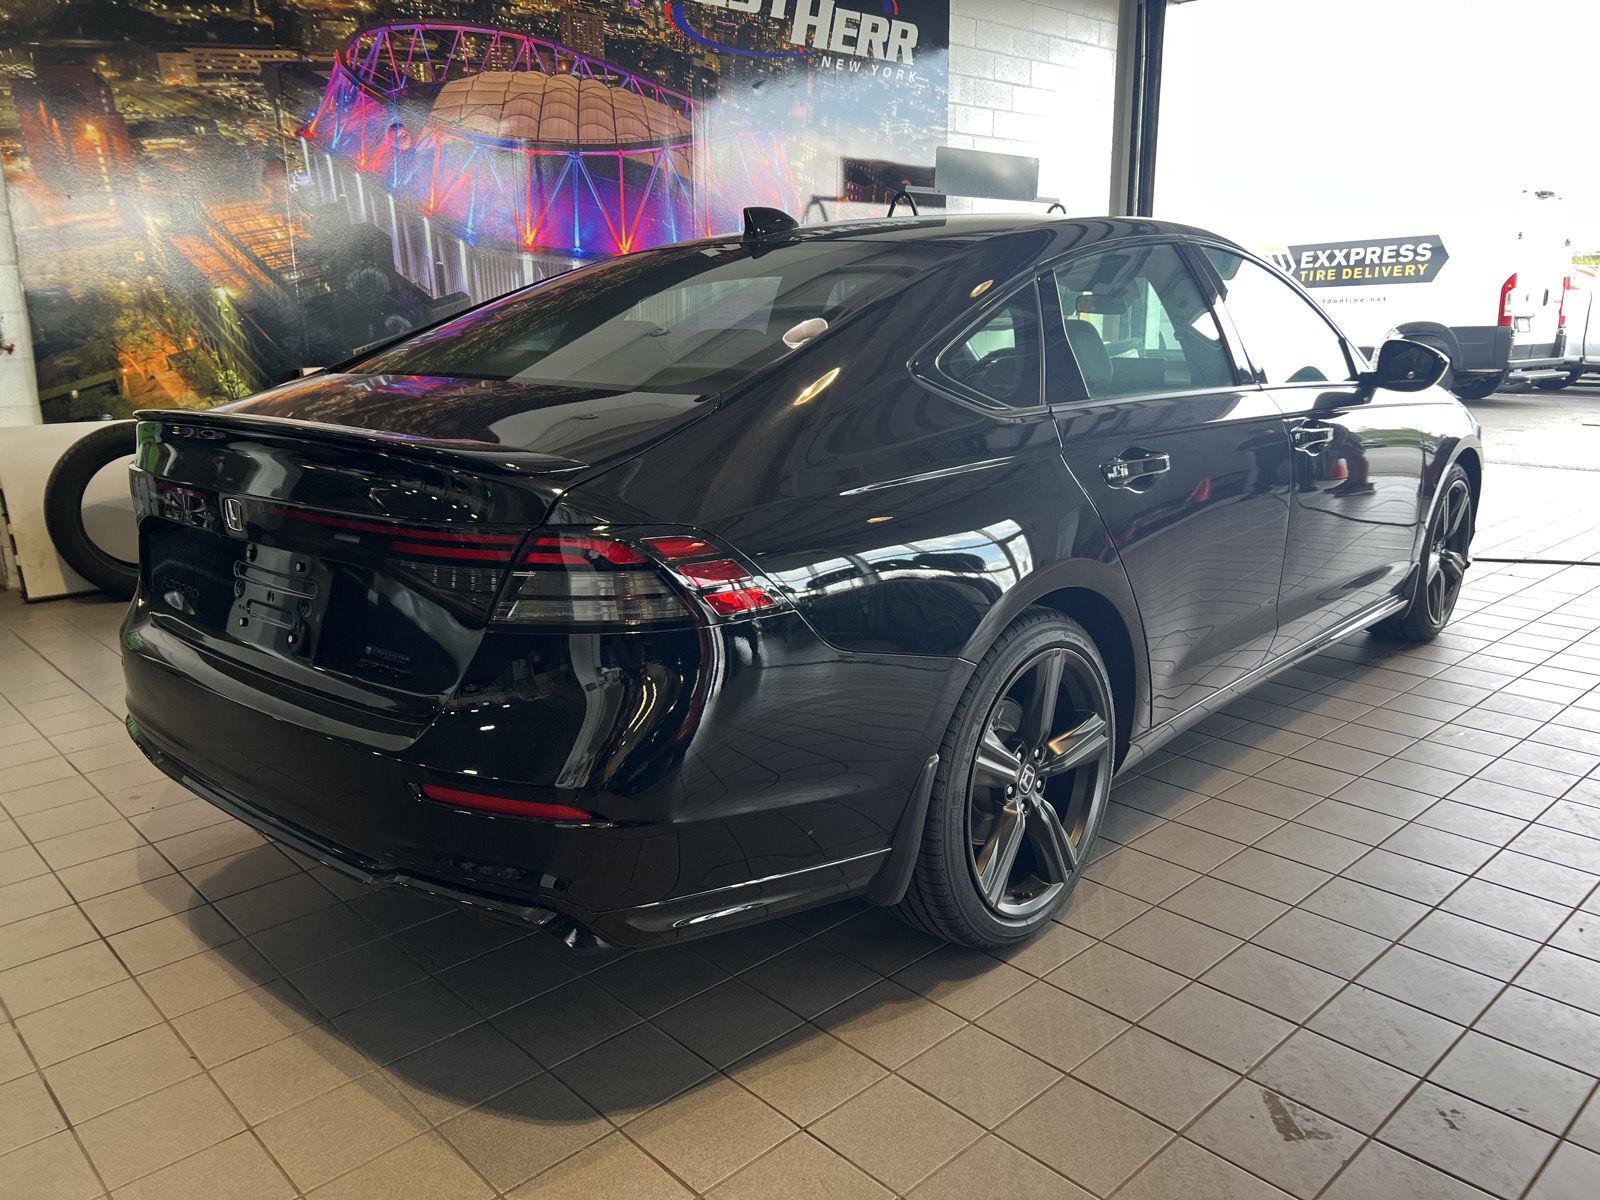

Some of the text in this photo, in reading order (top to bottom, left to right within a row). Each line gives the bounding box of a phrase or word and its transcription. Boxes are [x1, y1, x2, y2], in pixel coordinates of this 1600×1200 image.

[821, 56, 917, 82] NEW YORK
[1300, 243, 1433, 269] EXXPRESS
[1300, 264, 1430, 282] TIRE DELIVERY
